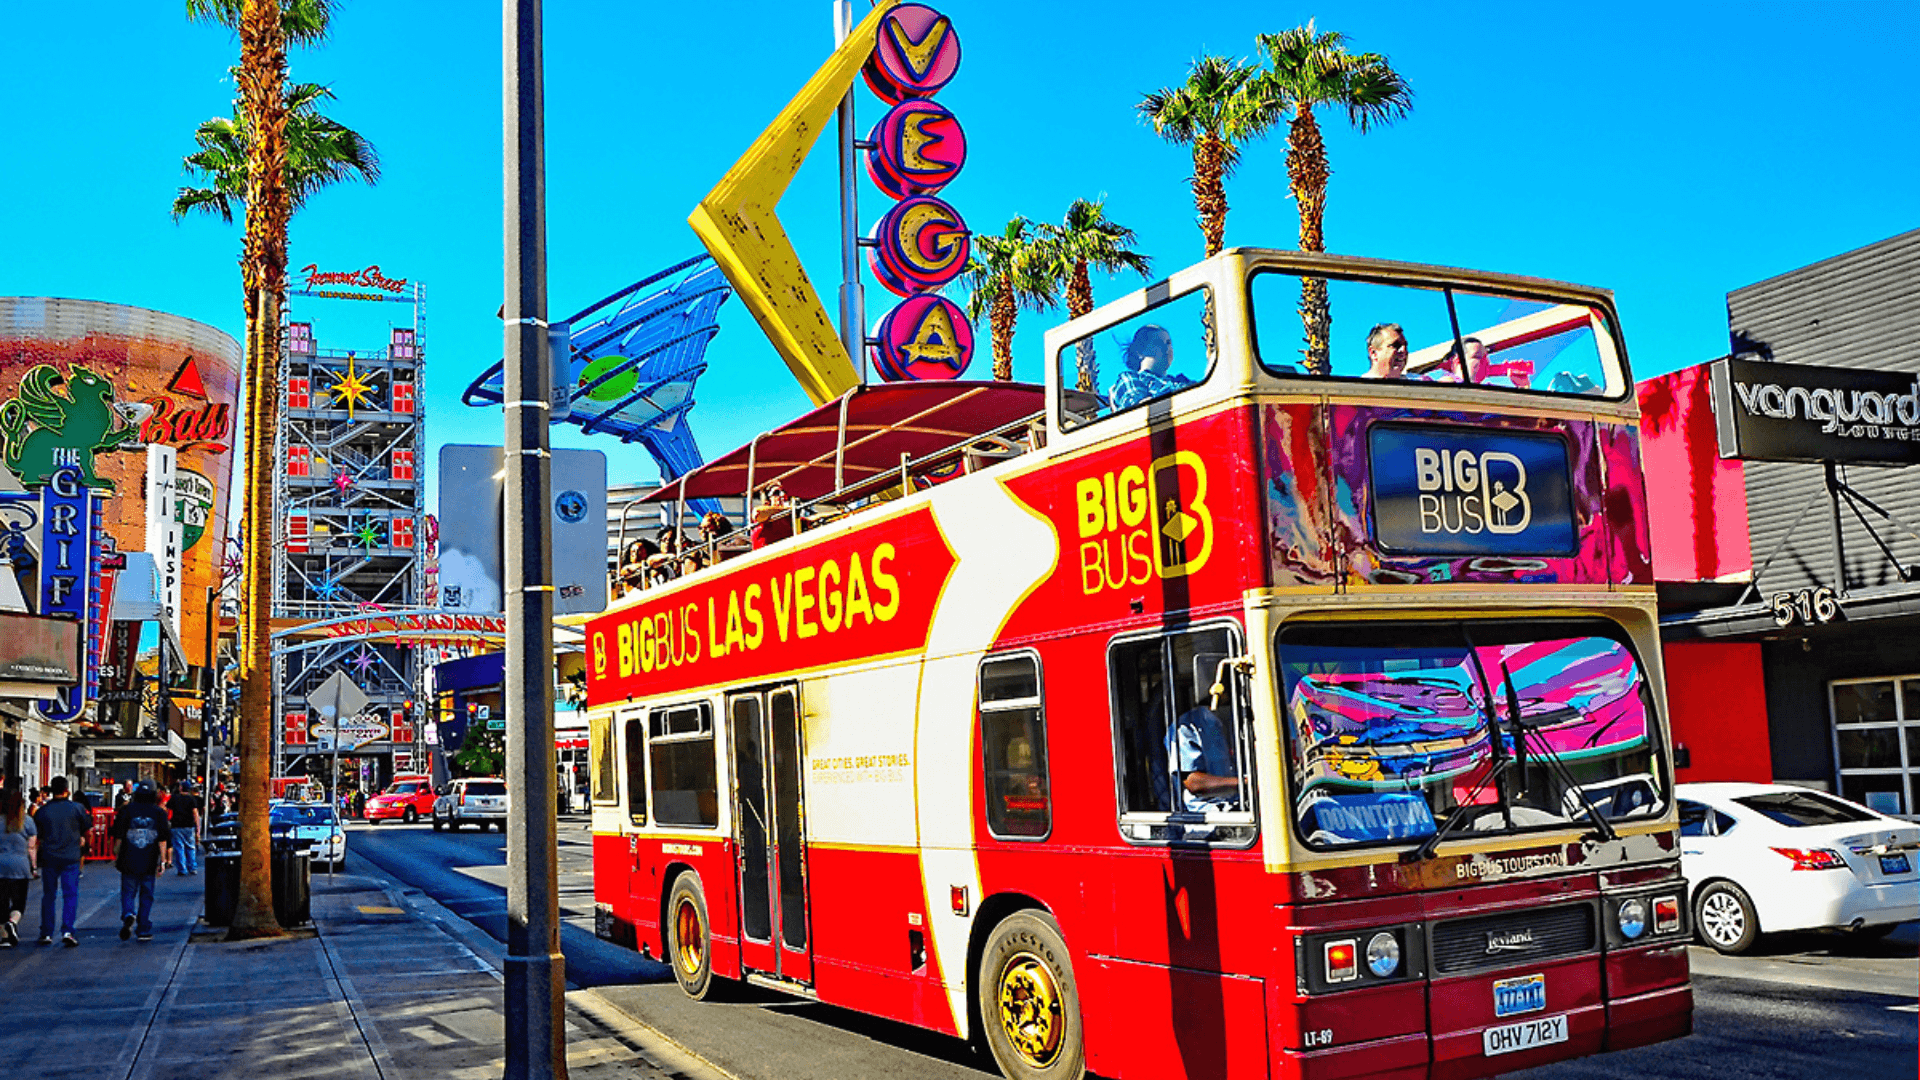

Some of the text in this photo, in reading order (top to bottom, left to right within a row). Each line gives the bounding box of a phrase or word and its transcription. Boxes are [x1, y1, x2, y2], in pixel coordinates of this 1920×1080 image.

[300, 264, 407, 293] Fremont Street
[140, 396, 229, 444] Bass
[1735, 382, 1920, 433] vanguard
[52, 447, 80, 467] THE
[1415, 448, 1479, 492] BIG
[1077, 465, 1148, 538] BIG
[1419, 493, 1484, 534] BUS
[1080, 529, 1152, 595] BUS
[708, 583, 764, 658] LAS
[771, 542, 900, 642] VEGAS
[1772, 586, 1836, 627] 516
[1319, 801, 1430, 831] DOWNTOWN
[1490, 1018, 1562, 1050] OHV 712Y
